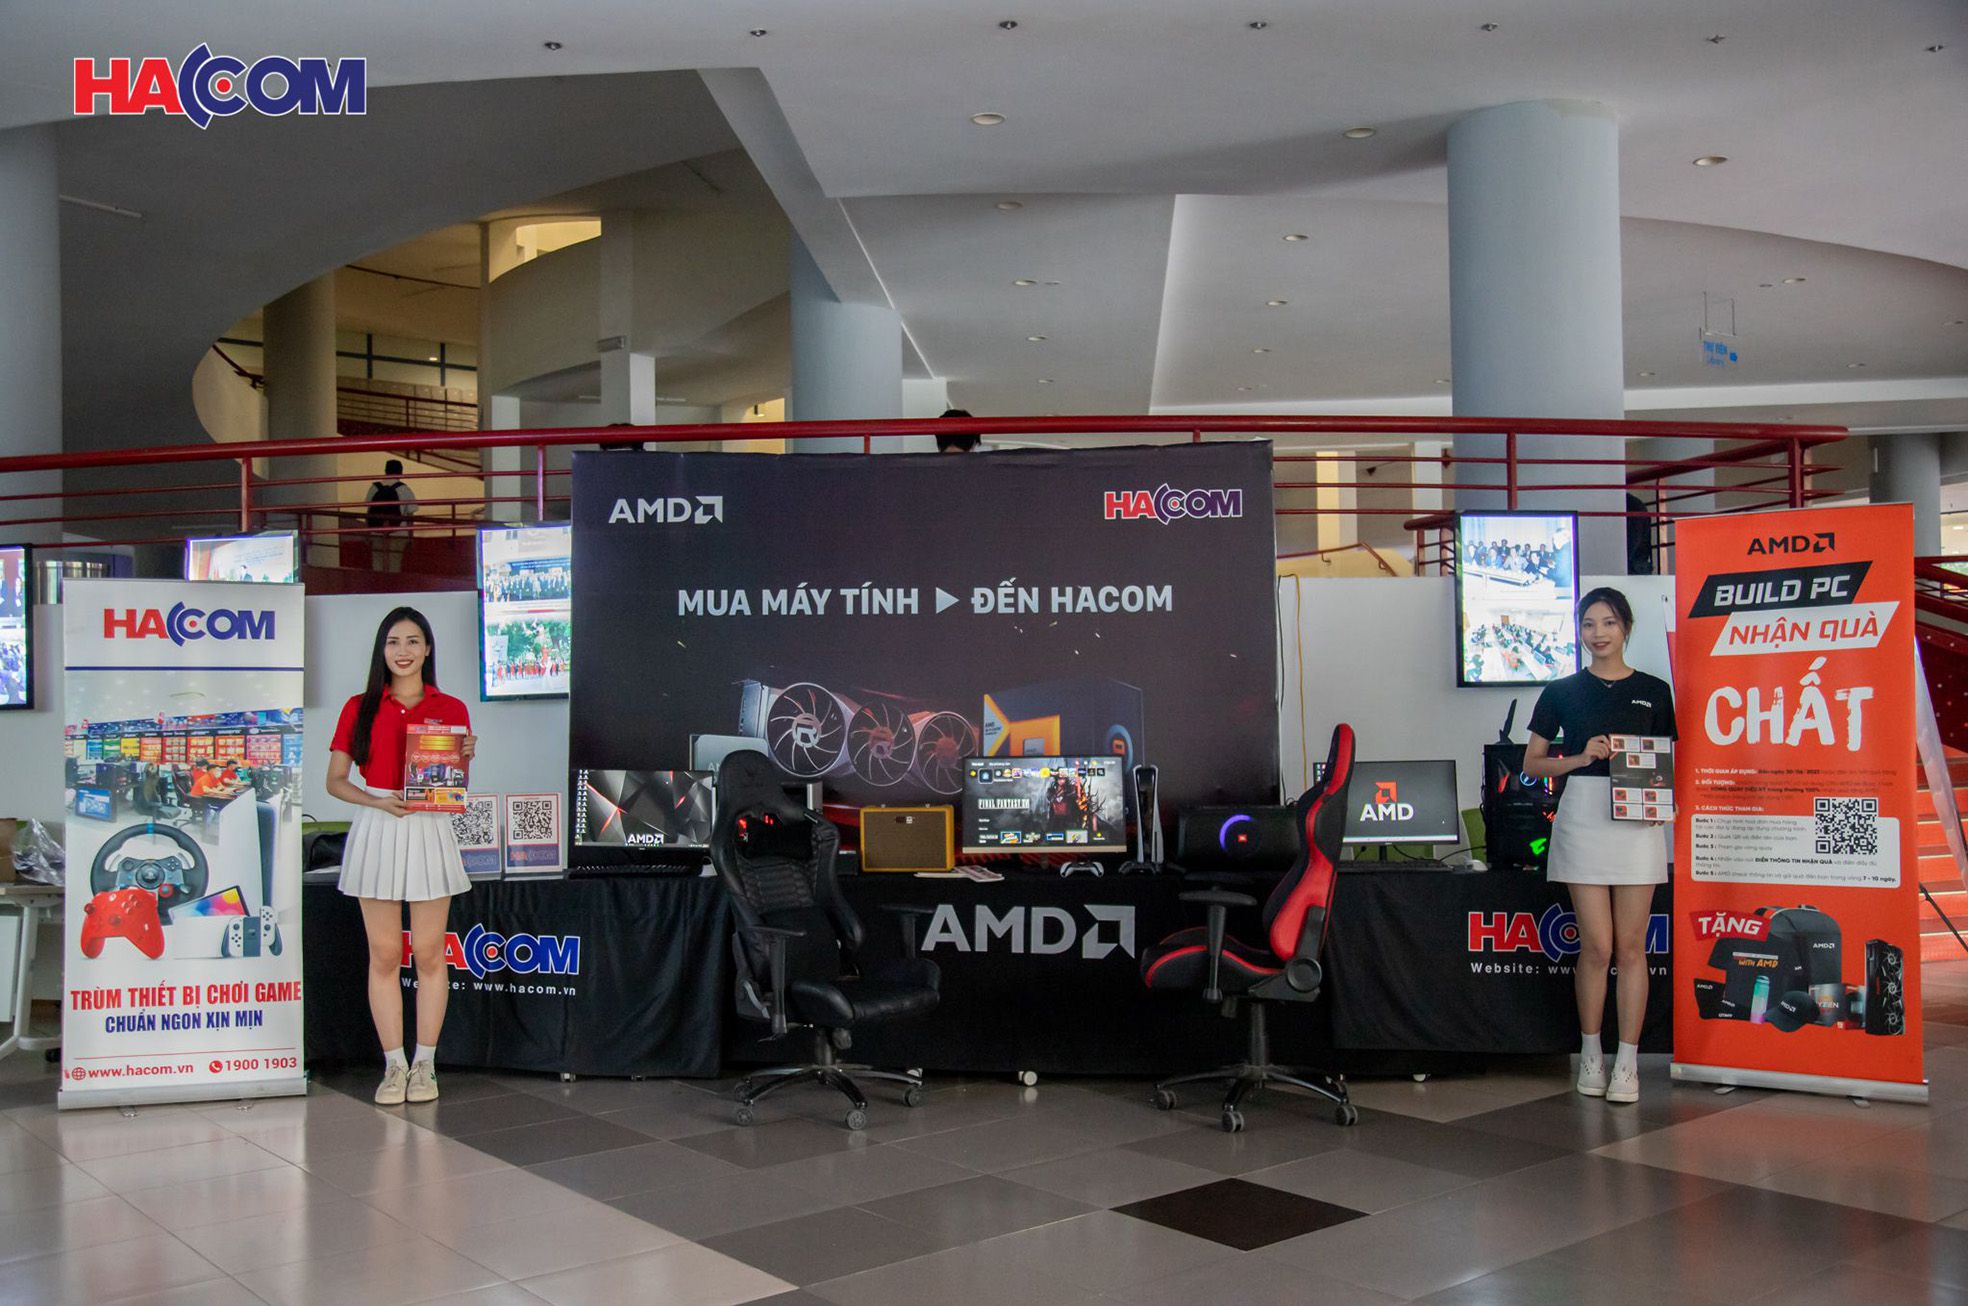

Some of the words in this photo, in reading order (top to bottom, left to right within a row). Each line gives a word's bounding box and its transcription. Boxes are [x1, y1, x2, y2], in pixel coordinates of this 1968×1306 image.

[609, 498, 692, 523] AMD
[1104, 483, 1243, 525] HACOM
[1747, 536, 1810, 555] AMD
[678, 589, 751, 616] MUA
[761, 582, 831, 616] MÁY
[840, 581, 919, 616] TÍNH
[971, 578, 1040, 615] ĐẾN
[1050, 585, 1173, 613] HACOM
[1714, 579, 1802, 607] BUILD
[1810, 575, 1851, 600] PC
[104, 601, 275, 647] HACOM
[1729, 616, 1810, 648] NHẬN
[1818, 610, 1879, 642] QUÀ
[1704, 656, 1875, 752] CHẤT
[1360, 803, 1414, 821] AMD
[628, 834, 653, 844] AMD
[921, 904, 1077, 954] AMD
[1698, 911, 1763, 937] TẶNG
[1471, 962, 1540, 975] Website:
[70, 985, 122, 1011] TRÙM
[128, 978, 177, 1008] THIẾT
[183, 985, 200, 1009] BỊ
[207, 980, 249, 1004] CHƠI
[255, 981, 302, 1002] GAME
[474, 981, 576, 996] www.hacom.vn
[105, 1007, 156, 1034] CHUẨN
[161, 1012, 200, 1031] NGON
[206, 1010, 230, 1032] XỊN
[235, 1010, 263, 1031] MỊN
[88, 1063, 194, 1079] www.hacom.vn
[225, 1058, 259, 1072] 1900
[264, 1057, 297, 1070] 1903
